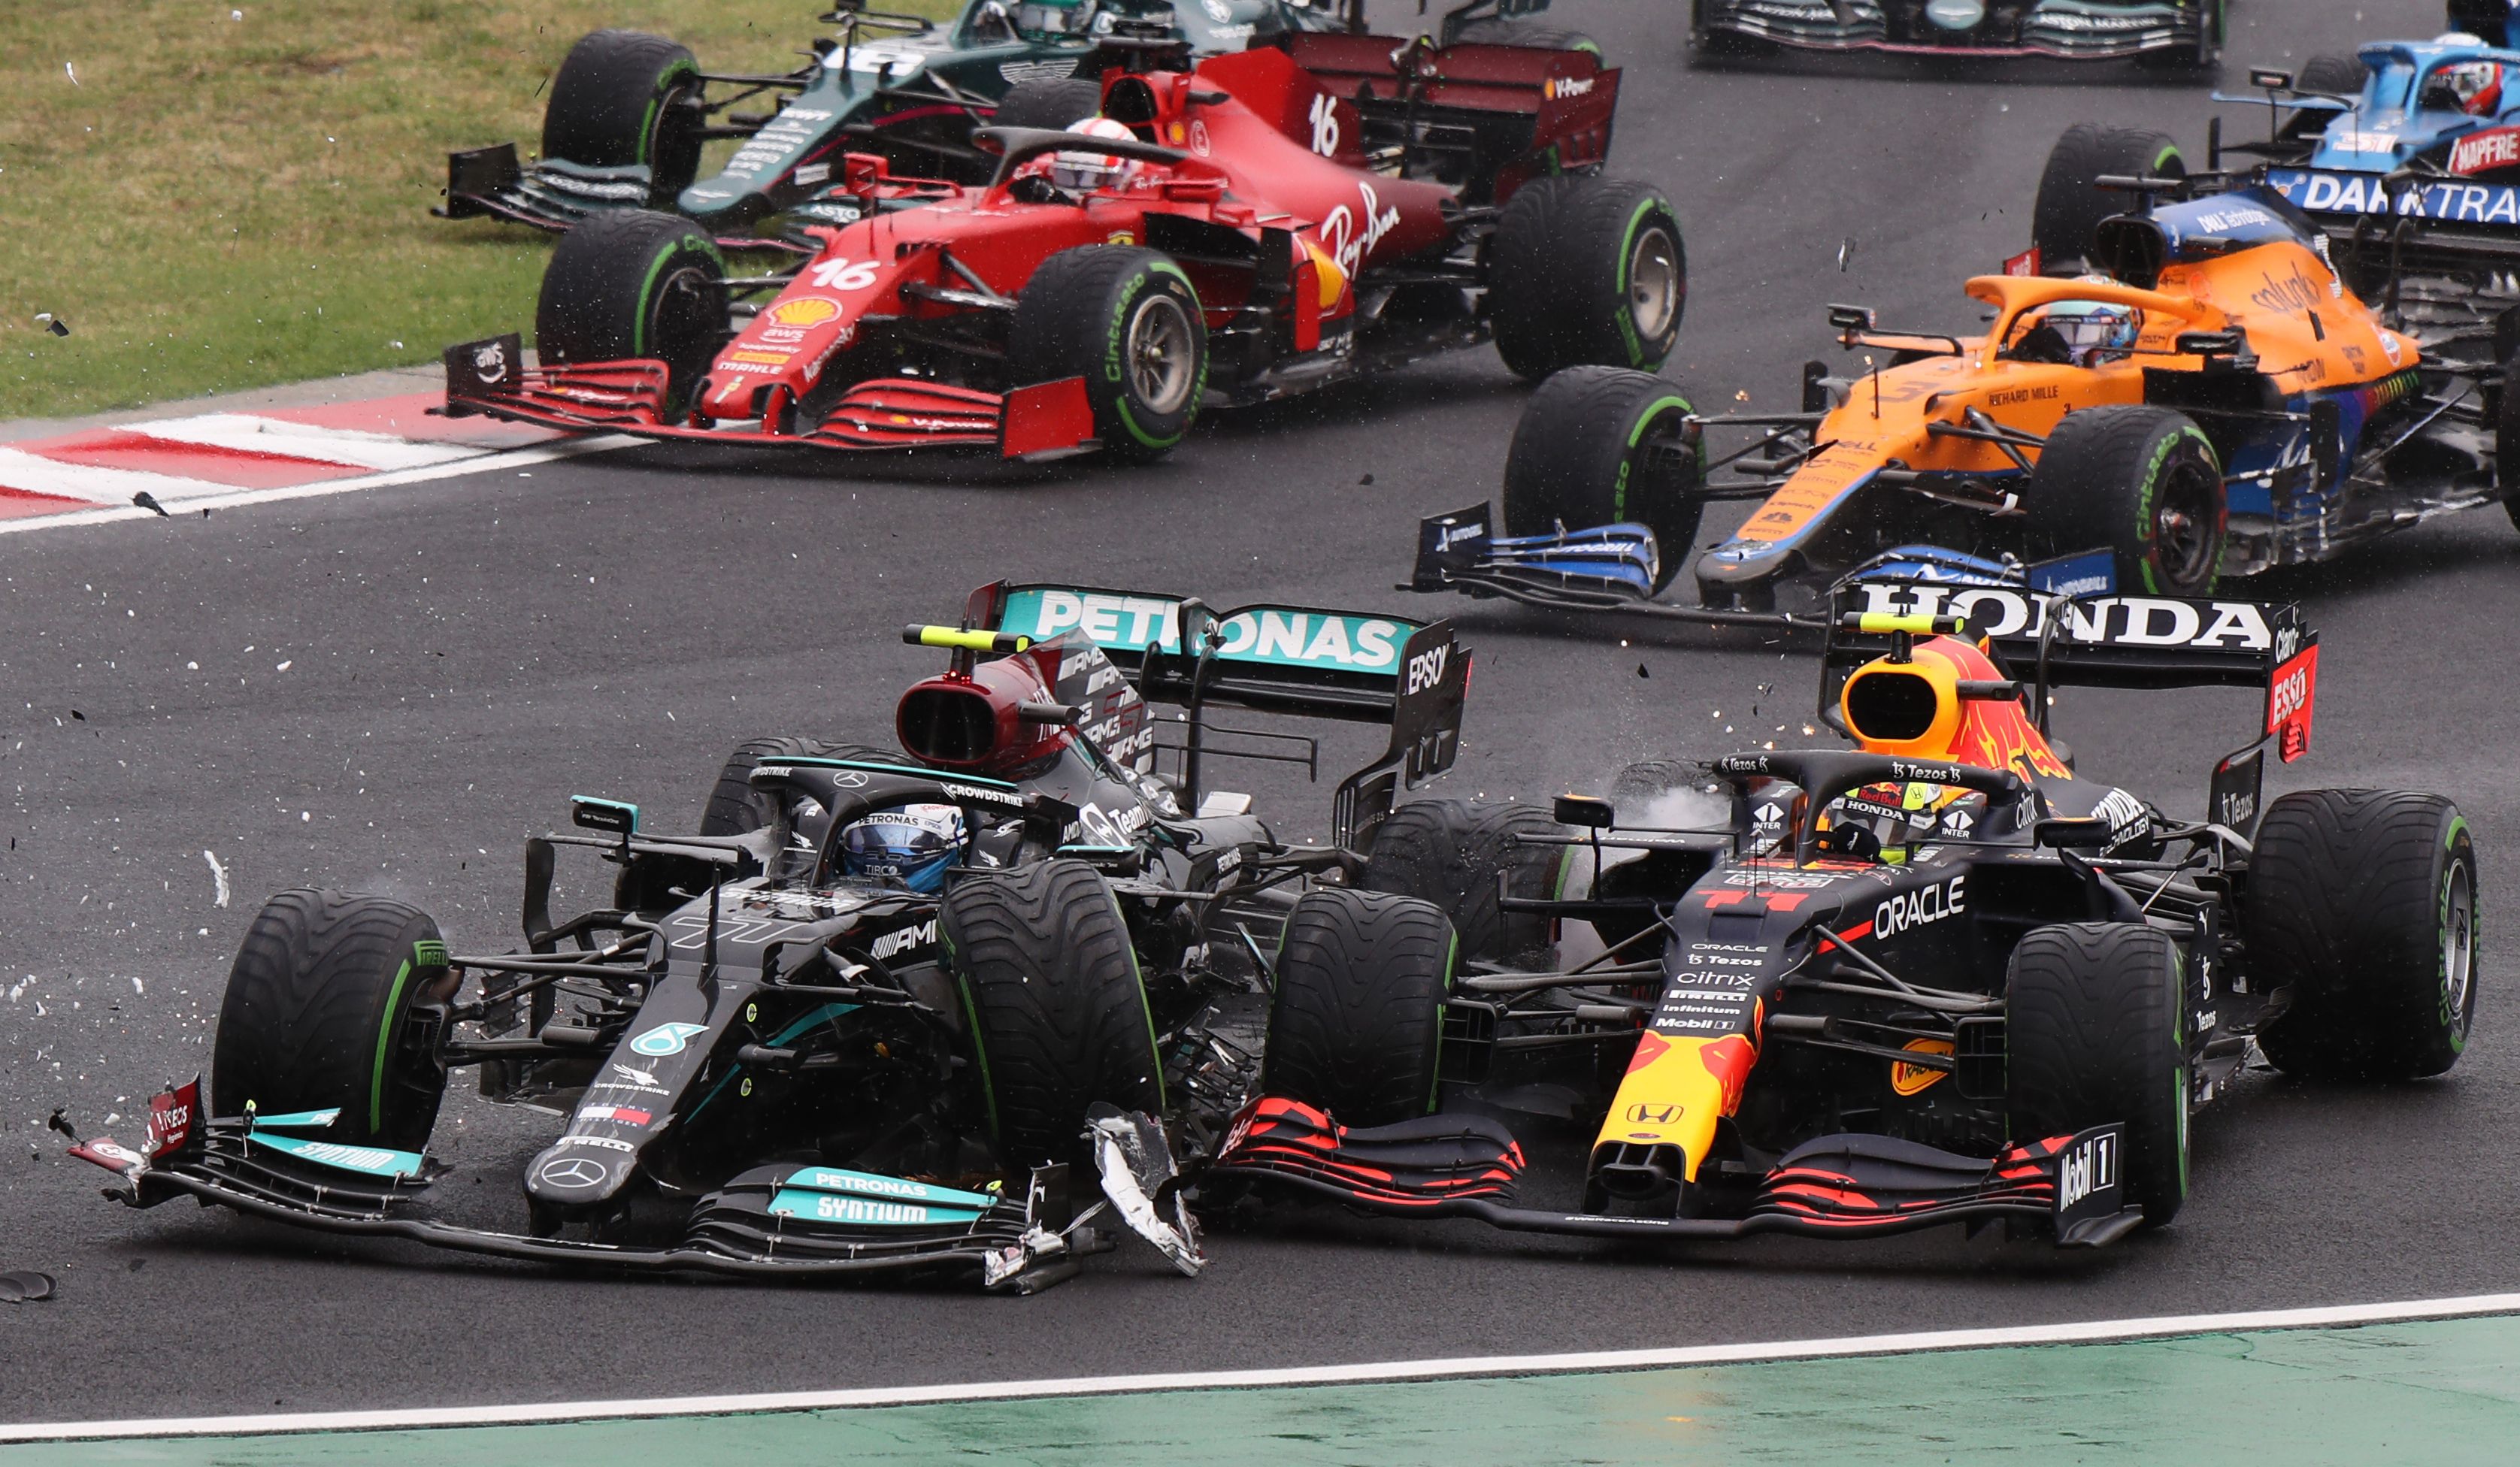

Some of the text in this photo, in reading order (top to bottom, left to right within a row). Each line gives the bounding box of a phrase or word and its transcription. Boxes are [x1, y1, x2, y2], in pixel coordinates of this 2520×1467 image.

[1309, 94, 1339, 157] 16
[2333, 132, 2400, 154] 31
[2456, 135, 2518, 174] MAPFRE
[2303, 175, 2520, 225] DARKTRA
[810, 204, 862, 220] ASTO
[812, 257, 881, 290] 16
[763, 328, 807, 339] aws
[717, 361, 784, 374] MAHLE
[1988, 386, 2058, 407] RICHARD MILLE
[1730, 758, 1757, 771] Tezos
[1907, 764, 1947, 780] Tezos
[949, 784, 1023, 808] CROWDSTRIKE
[1859, 788, 1902, 807] Red Bull
[1107, 803, 1149, 835] Team
[1846, 800, 1905, 821] HONDA
[2231, 792, 2254, 825] Tezos
[859, 814, 919, 827] PETRONAS
[1752, 821, 1781, 830] INTER
[1942, 827, 1970, 839] INTER
[1876, 875, 1965, 940] ORACLE
[671, 915, 810, 949] 77
[414, 940, 449, 966] PIRELL
[1692, 943, 1769, 953] ORACLE
[1708, 955, 1763, 967] Tezos
[1668, 989, 1748, 1002] PIRELLI
[1662, 1003, 1741, 1015] Infinitum
[1655, 1018, 1713, 1030] Mobil
[2196, 1010, 2216, 1033] Tezos
[593, 1082, 671, 1096] CROWDSTRIKE
[591, 1102, 648, 1112] TOMMY
[556, 1136, 635, 1153] PRELLI
[292, 1142, 396, 1170] SYNTIUM
[816, 1172, 928, 1196] PETRONAS
[2060, 1140, 2092, 1212] Mobil
[817, 1196, 927, 1224] SYNTIUM
